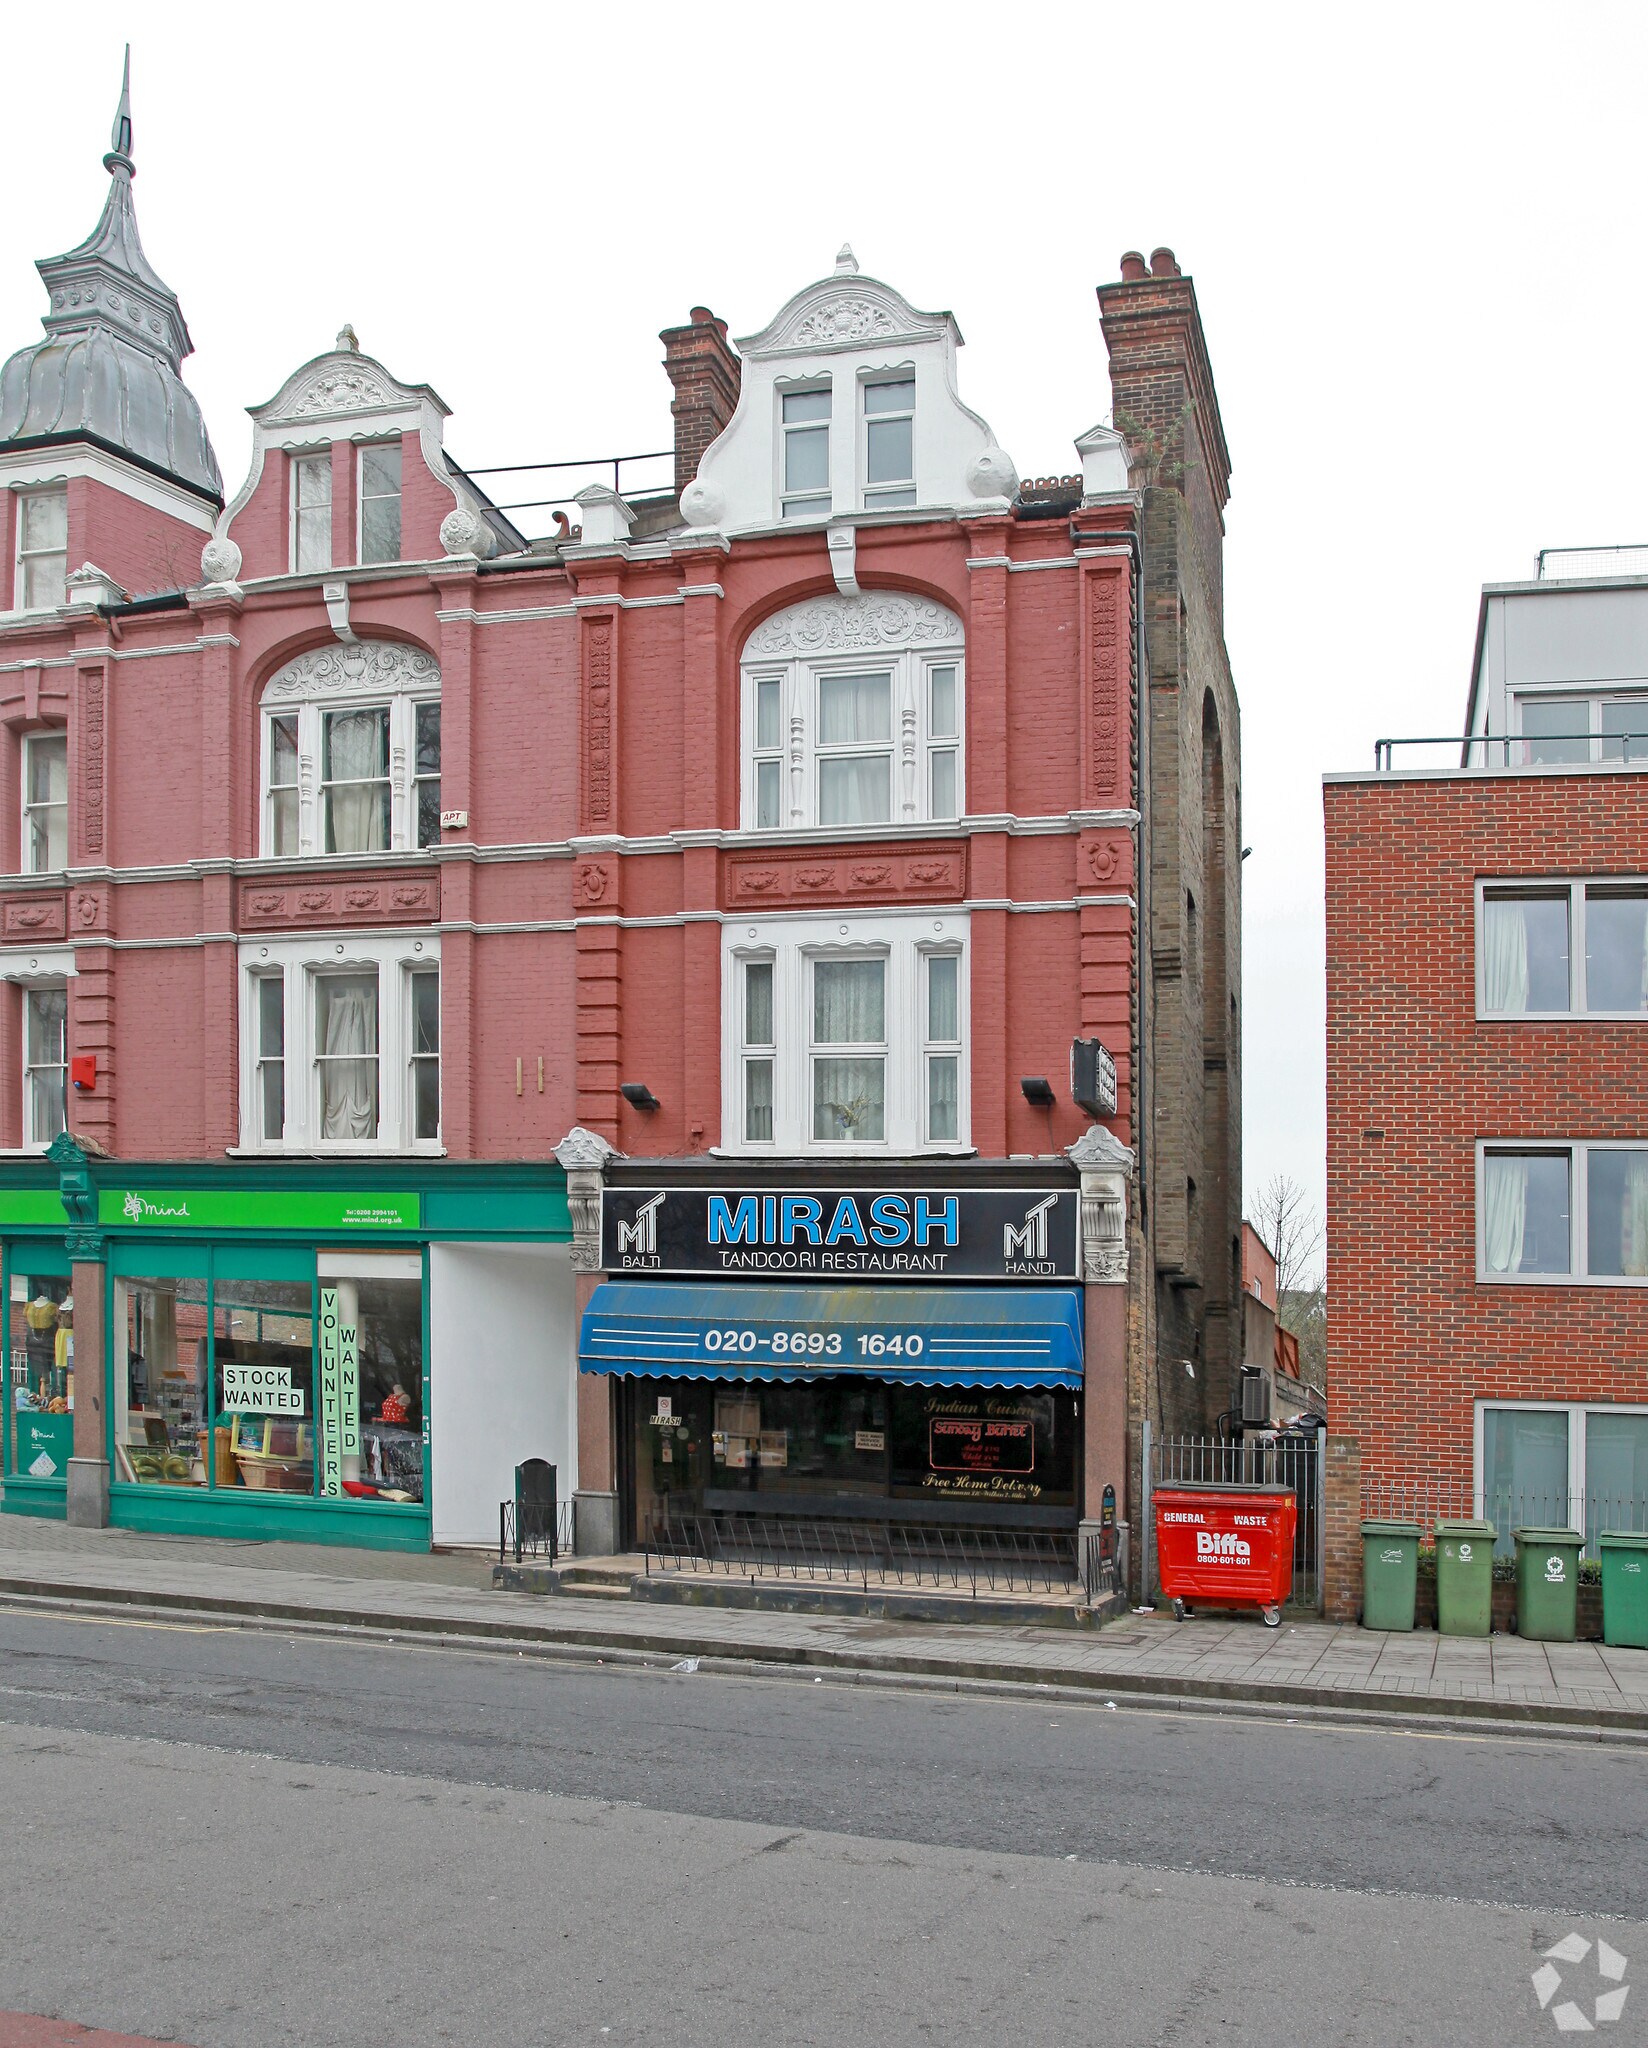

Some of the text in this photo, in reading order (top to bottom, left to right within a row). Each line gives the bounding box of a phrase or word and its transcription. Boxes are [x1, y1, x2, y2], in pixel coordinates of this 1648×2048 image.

[145, 1202, 190, 1216] mind
[342, 1216, 402, 1225] www.mind.org.uk
[707, 1195, 960, 1247] MIRASH
[622, 1256, 661, 1268] BALTI
[719, 1251, 948, 1270] TANDOORI RESTAURANT
[1005, 1261, 1056, 1274] HANDI
[704, 1329, 924, 1357] 020-8693 1640
[226, 1369, 289, 1387] STOCK
[323, 1293, 339, 1497] VOLUNTEERS
[340, 1329, 356, 1448] WANTED
[225, 1390, 301, 1408] WANTED
[924, 1398, 979, 1413] Indian
[650, 1415, 681, 1425] MIRASH
[922, 1473, 950, 1487] Free
[952, 1475, 990, 1489] Home
[1164, 1512, 1267, 1526] GENERAL WASTE
[1196, 1531, 1251, 1556] Biffa
